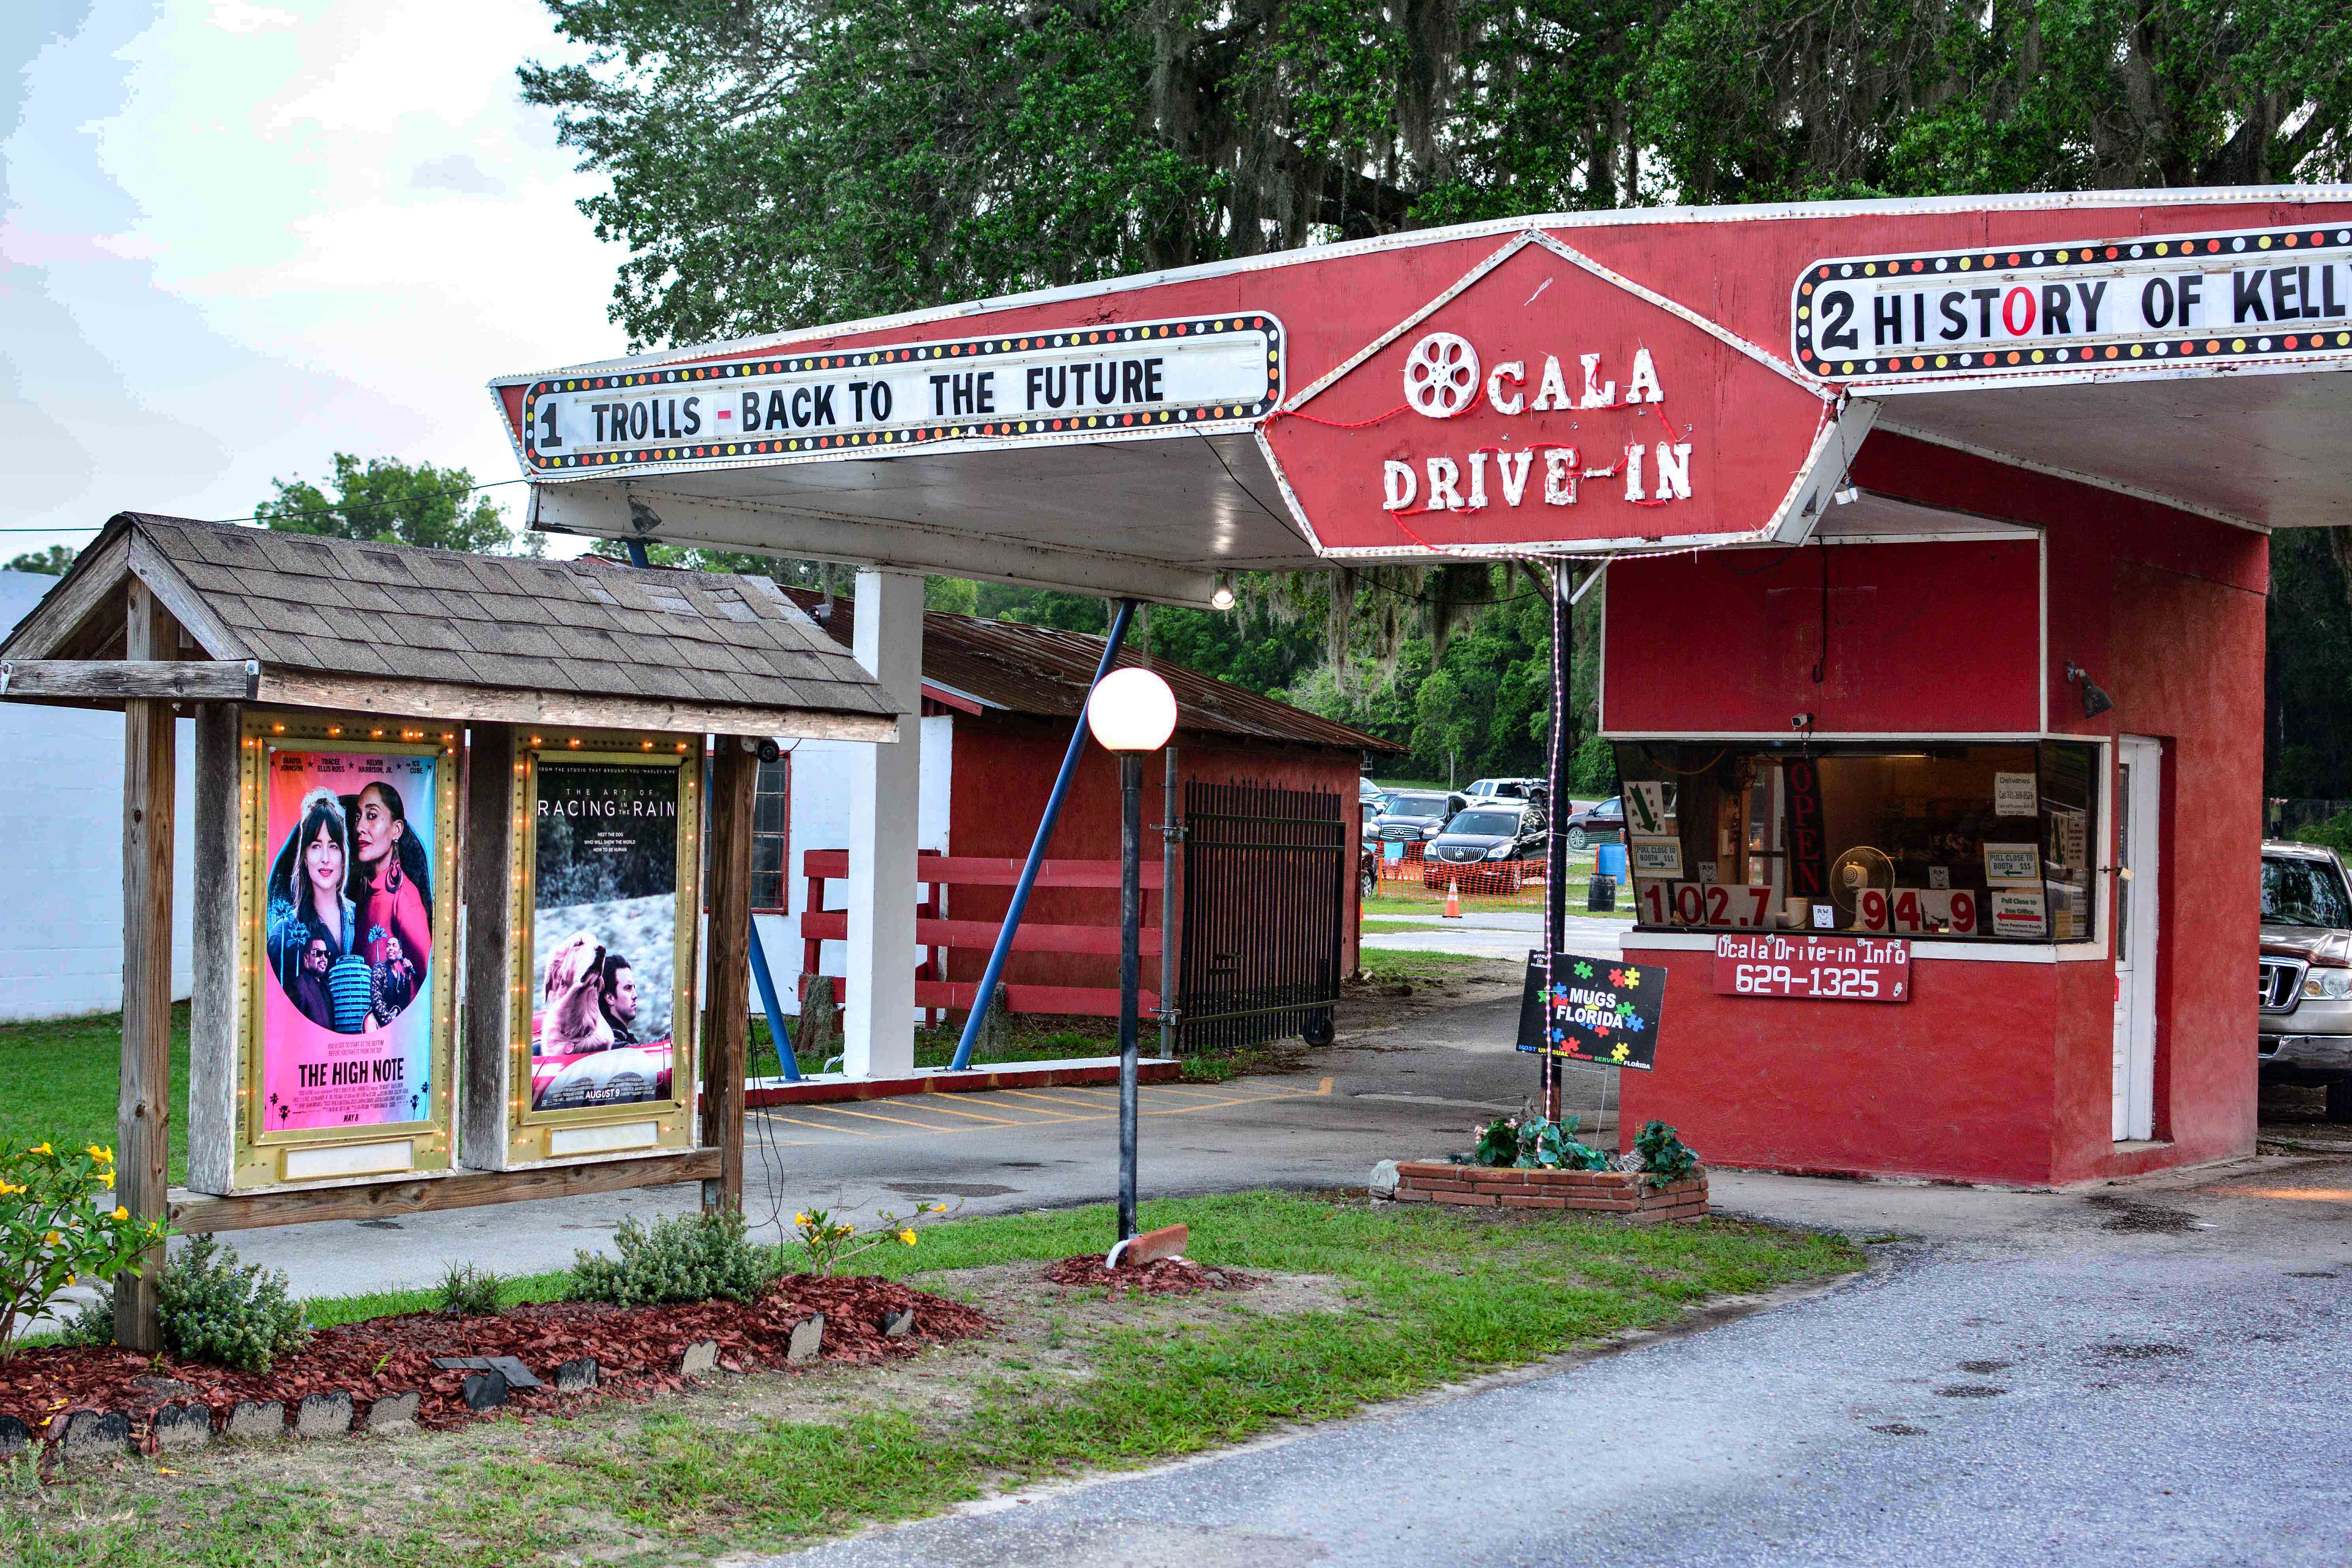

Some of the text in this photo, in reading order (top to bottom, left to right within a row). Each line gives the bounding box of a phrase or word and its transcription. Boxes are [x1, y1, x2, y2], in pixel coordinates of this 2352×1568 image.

[1821, 264, 2352, 351] 2 HISTORY OF KELL
[541, 403, 562, 448] 1
[592, 397, 701, 441] TROLLS
[743, 384, 835, 432] BACK
[849, 381, 892, 422] TO
[929, 371, 994, 416] THE
[1027, 358, 1163, 410] FUTURE
[1383, 443, 1692, 510] DRIVE-IN
[538, 800, 615, 816] RACING
[634, 801, 674, 816] RAIN
[1626, 796, 1642, 829] PAY
[1646, 788, 1661, 831] HERE
[1790, 761, 1819, 893] OPEN
[1645, 885, 1771, 926] 102.7
[1719, 937, 1905, 964] Ocala Drive-in Info
[1736, 964, 1879, 997] 629-1325
[1570, 988, 1616, 1008] MUGS
[1556, 1005, 1623, 1028] FLORIDA
[299, 1057, 404, 1087] THE HIGH NOTE
[1538, 1048, 1568, 1057] UNSUAL
[1570, 1052, 1592, 1060] GROUP
[1623, 1061, 1650, 1069] FLORIDA
[586, 1089, 614, 1099] AUGUST
